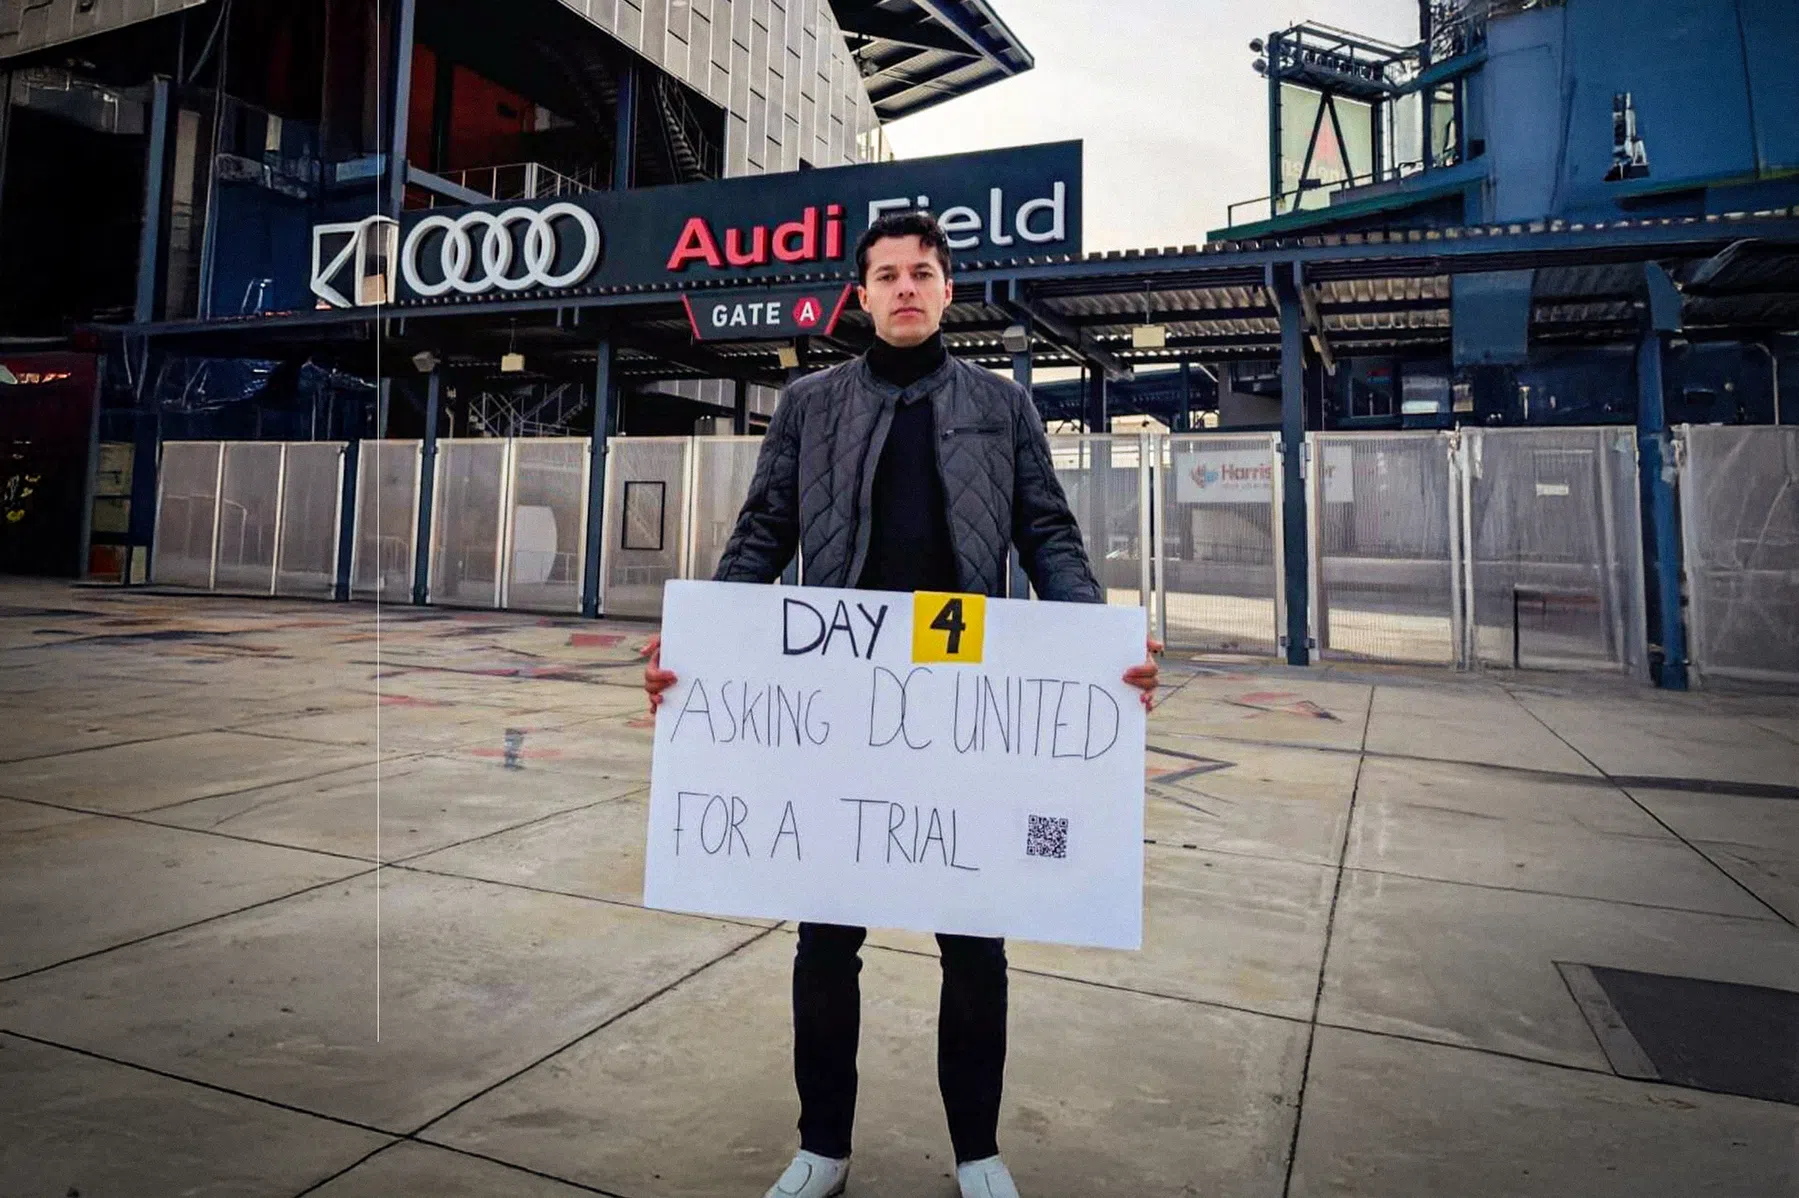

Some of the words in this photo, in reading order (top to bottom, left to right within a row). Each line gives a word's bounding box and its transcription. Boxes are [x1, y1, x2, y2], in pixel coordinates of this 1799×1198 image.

[666, 203, 845, 271] Audi
[712, 301, 781, 327] GATE
[799, 301, 816, 322] A
[781, 596, 889, 660] DAY
[929, 597, 967, 655] 4
[670, 678, 831, 747] ASKING
[869, 666, 934, 750] DC
[953, 671, 1121, 762] UNITED
[672, 791, 751, 858] FOR
[770, 800, 802, 863] A
[839, 797, 981, 872] TRIAL
